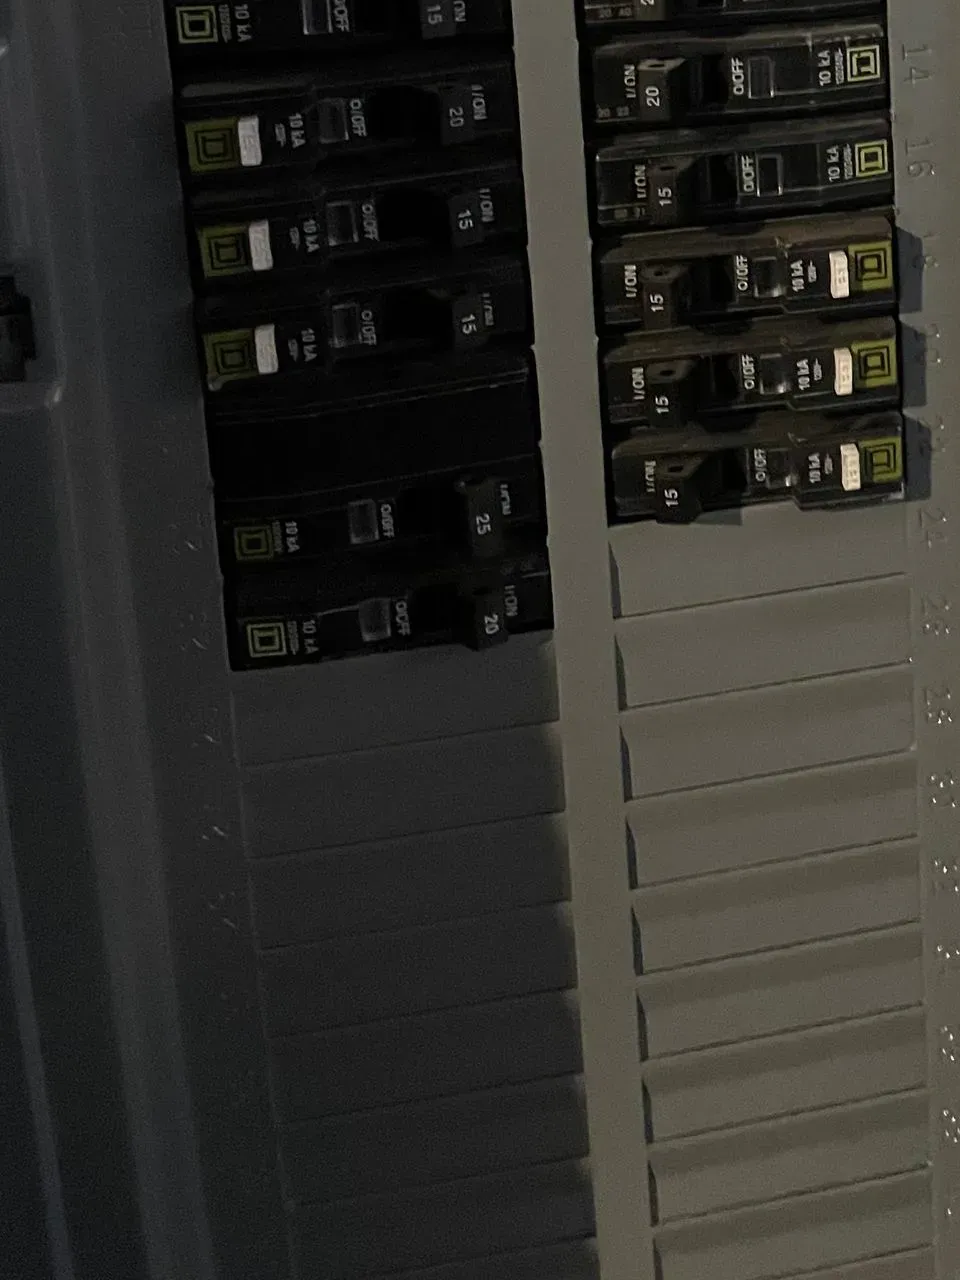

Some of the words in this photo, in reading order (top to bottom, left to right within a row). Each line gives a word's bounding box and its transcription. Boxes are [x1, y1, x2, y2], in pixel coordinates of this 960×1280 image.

[426, 4, 442, 25] 15
[646, 86, 660, 107] 20
[448, 106, 464, 129] 20
[658, 186, 672, 207] 15
[457, 208, 474, 231] 15
[650, 293, 664, 312] 15
[461, 313, 478, 335] 15
[656, 395, 669, 414] 15
[665, 487, 678, 507] 15
[475, 512, 492, 536] 25
[483, 614, 499, 636] 20
